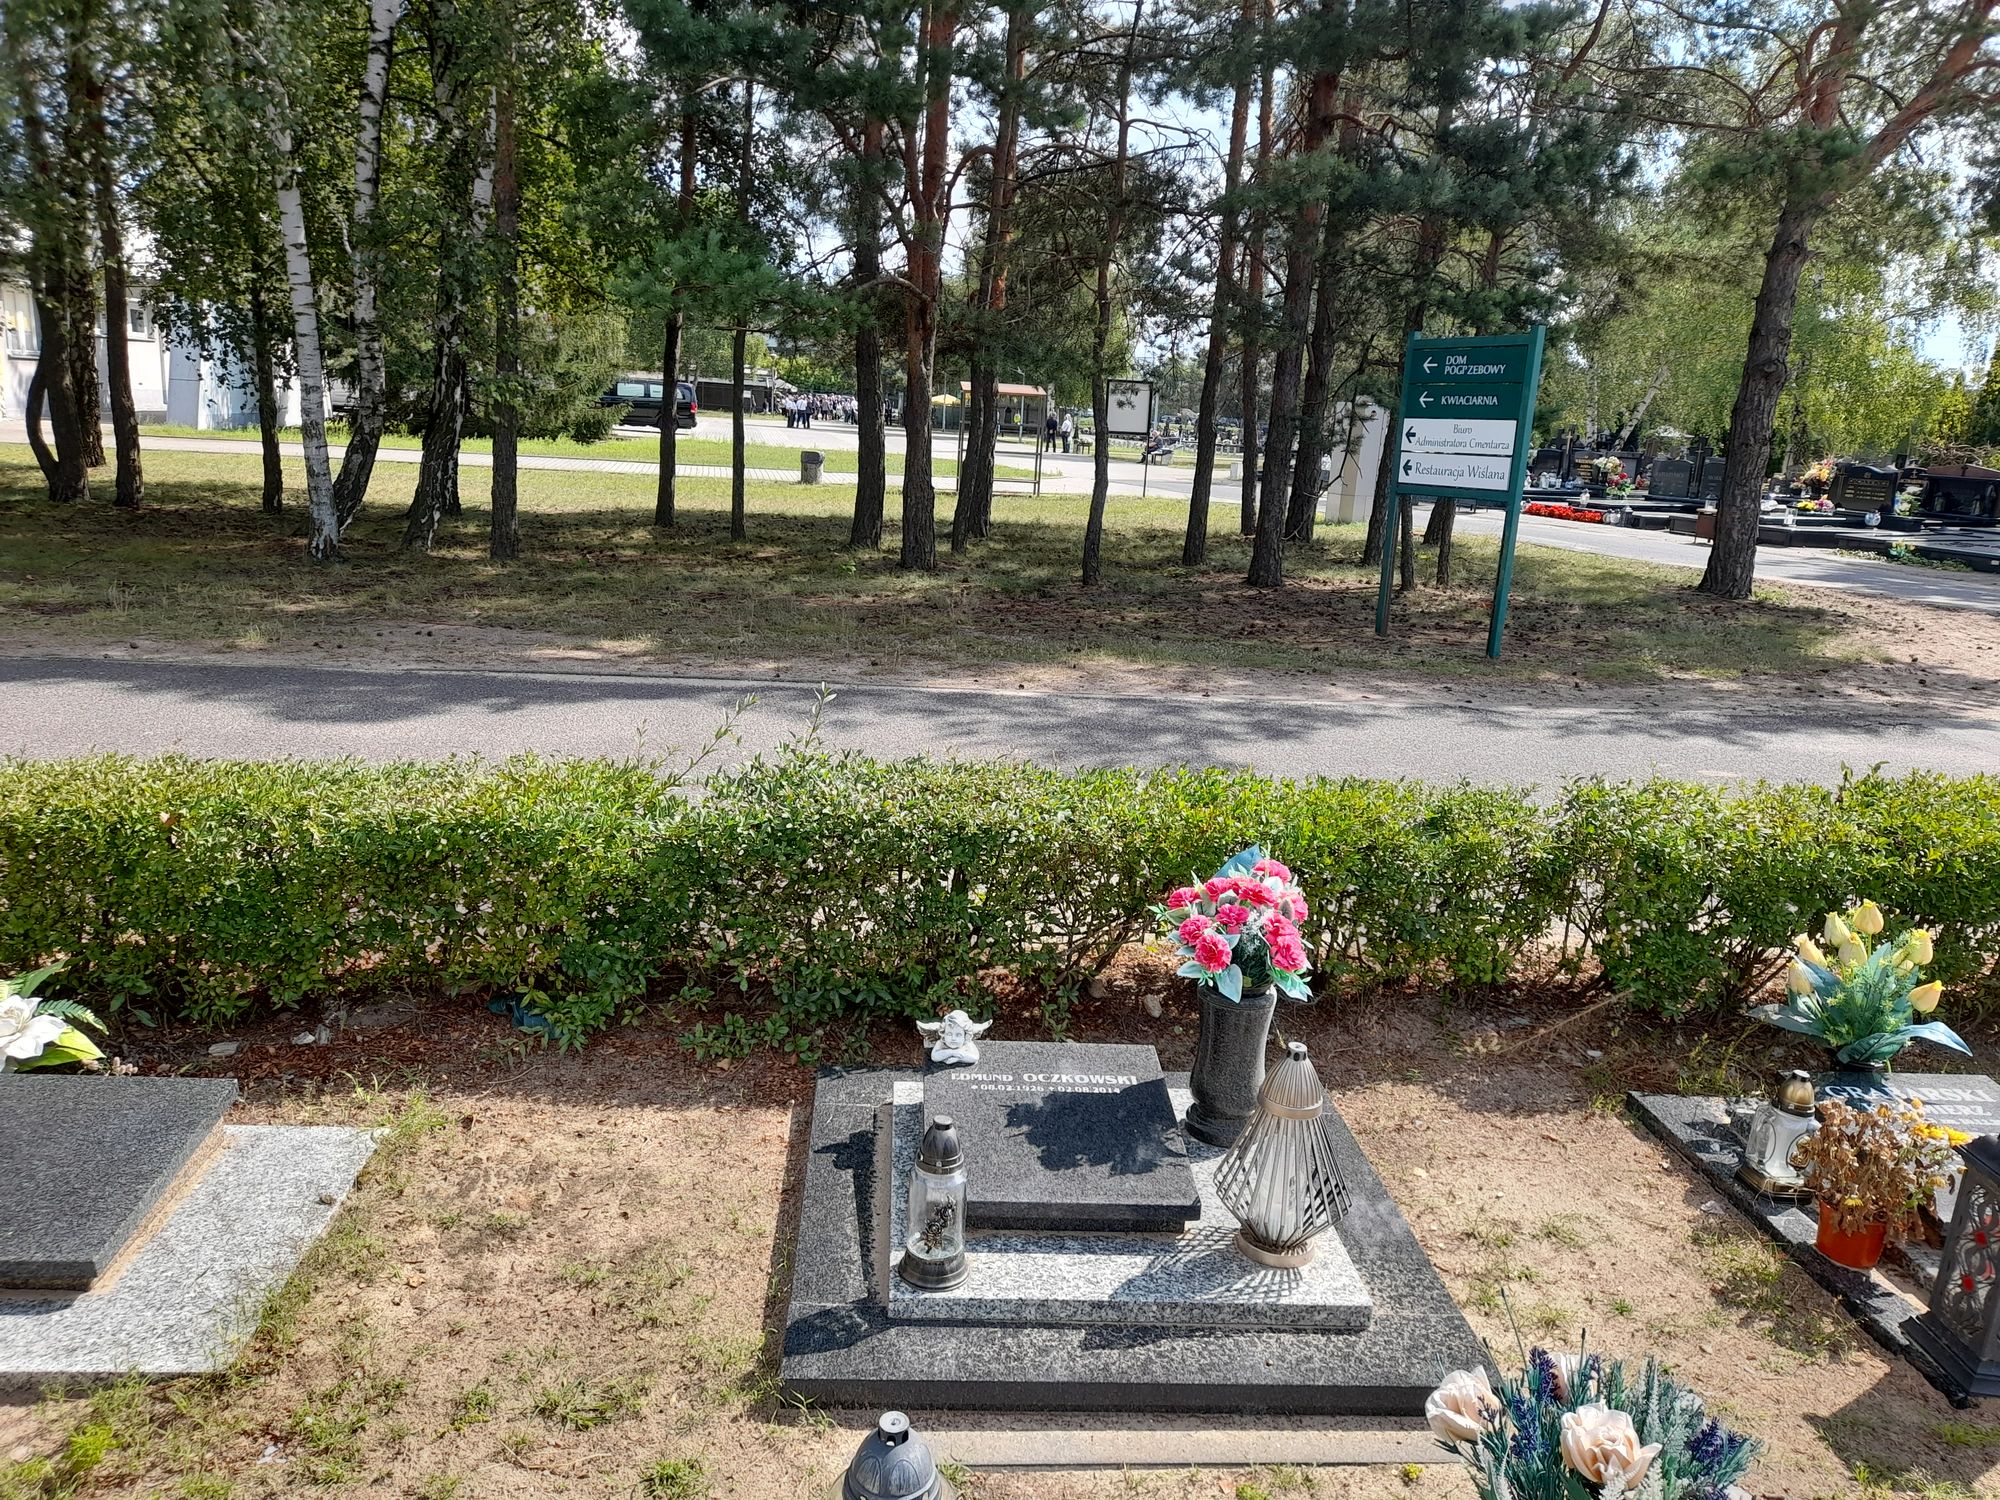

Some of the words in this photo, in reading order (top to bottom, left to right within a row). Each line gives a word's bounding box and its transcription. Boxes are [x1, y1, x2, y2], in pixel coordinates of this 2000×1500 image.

[1446, 355, 1467, 365] DOM
[1444, 364, 1506, 375] POGRZEBOWY
[1441, 395, 1498, 405] KWIACIARNIA
[1453, 423, 1473, 434] Biuro
[1415, 436, 1467, 448] Administratora
[1469, 438, 1510, 449] Cmentarza
[1415, 461, 1465, 481] Restauracja
[1467, 464, 1505, 480] Wiślana
[951, 1073, 1014, 1082] EDMUND
[1022, 1073, 1138, 1085] OCZKOWSKI
